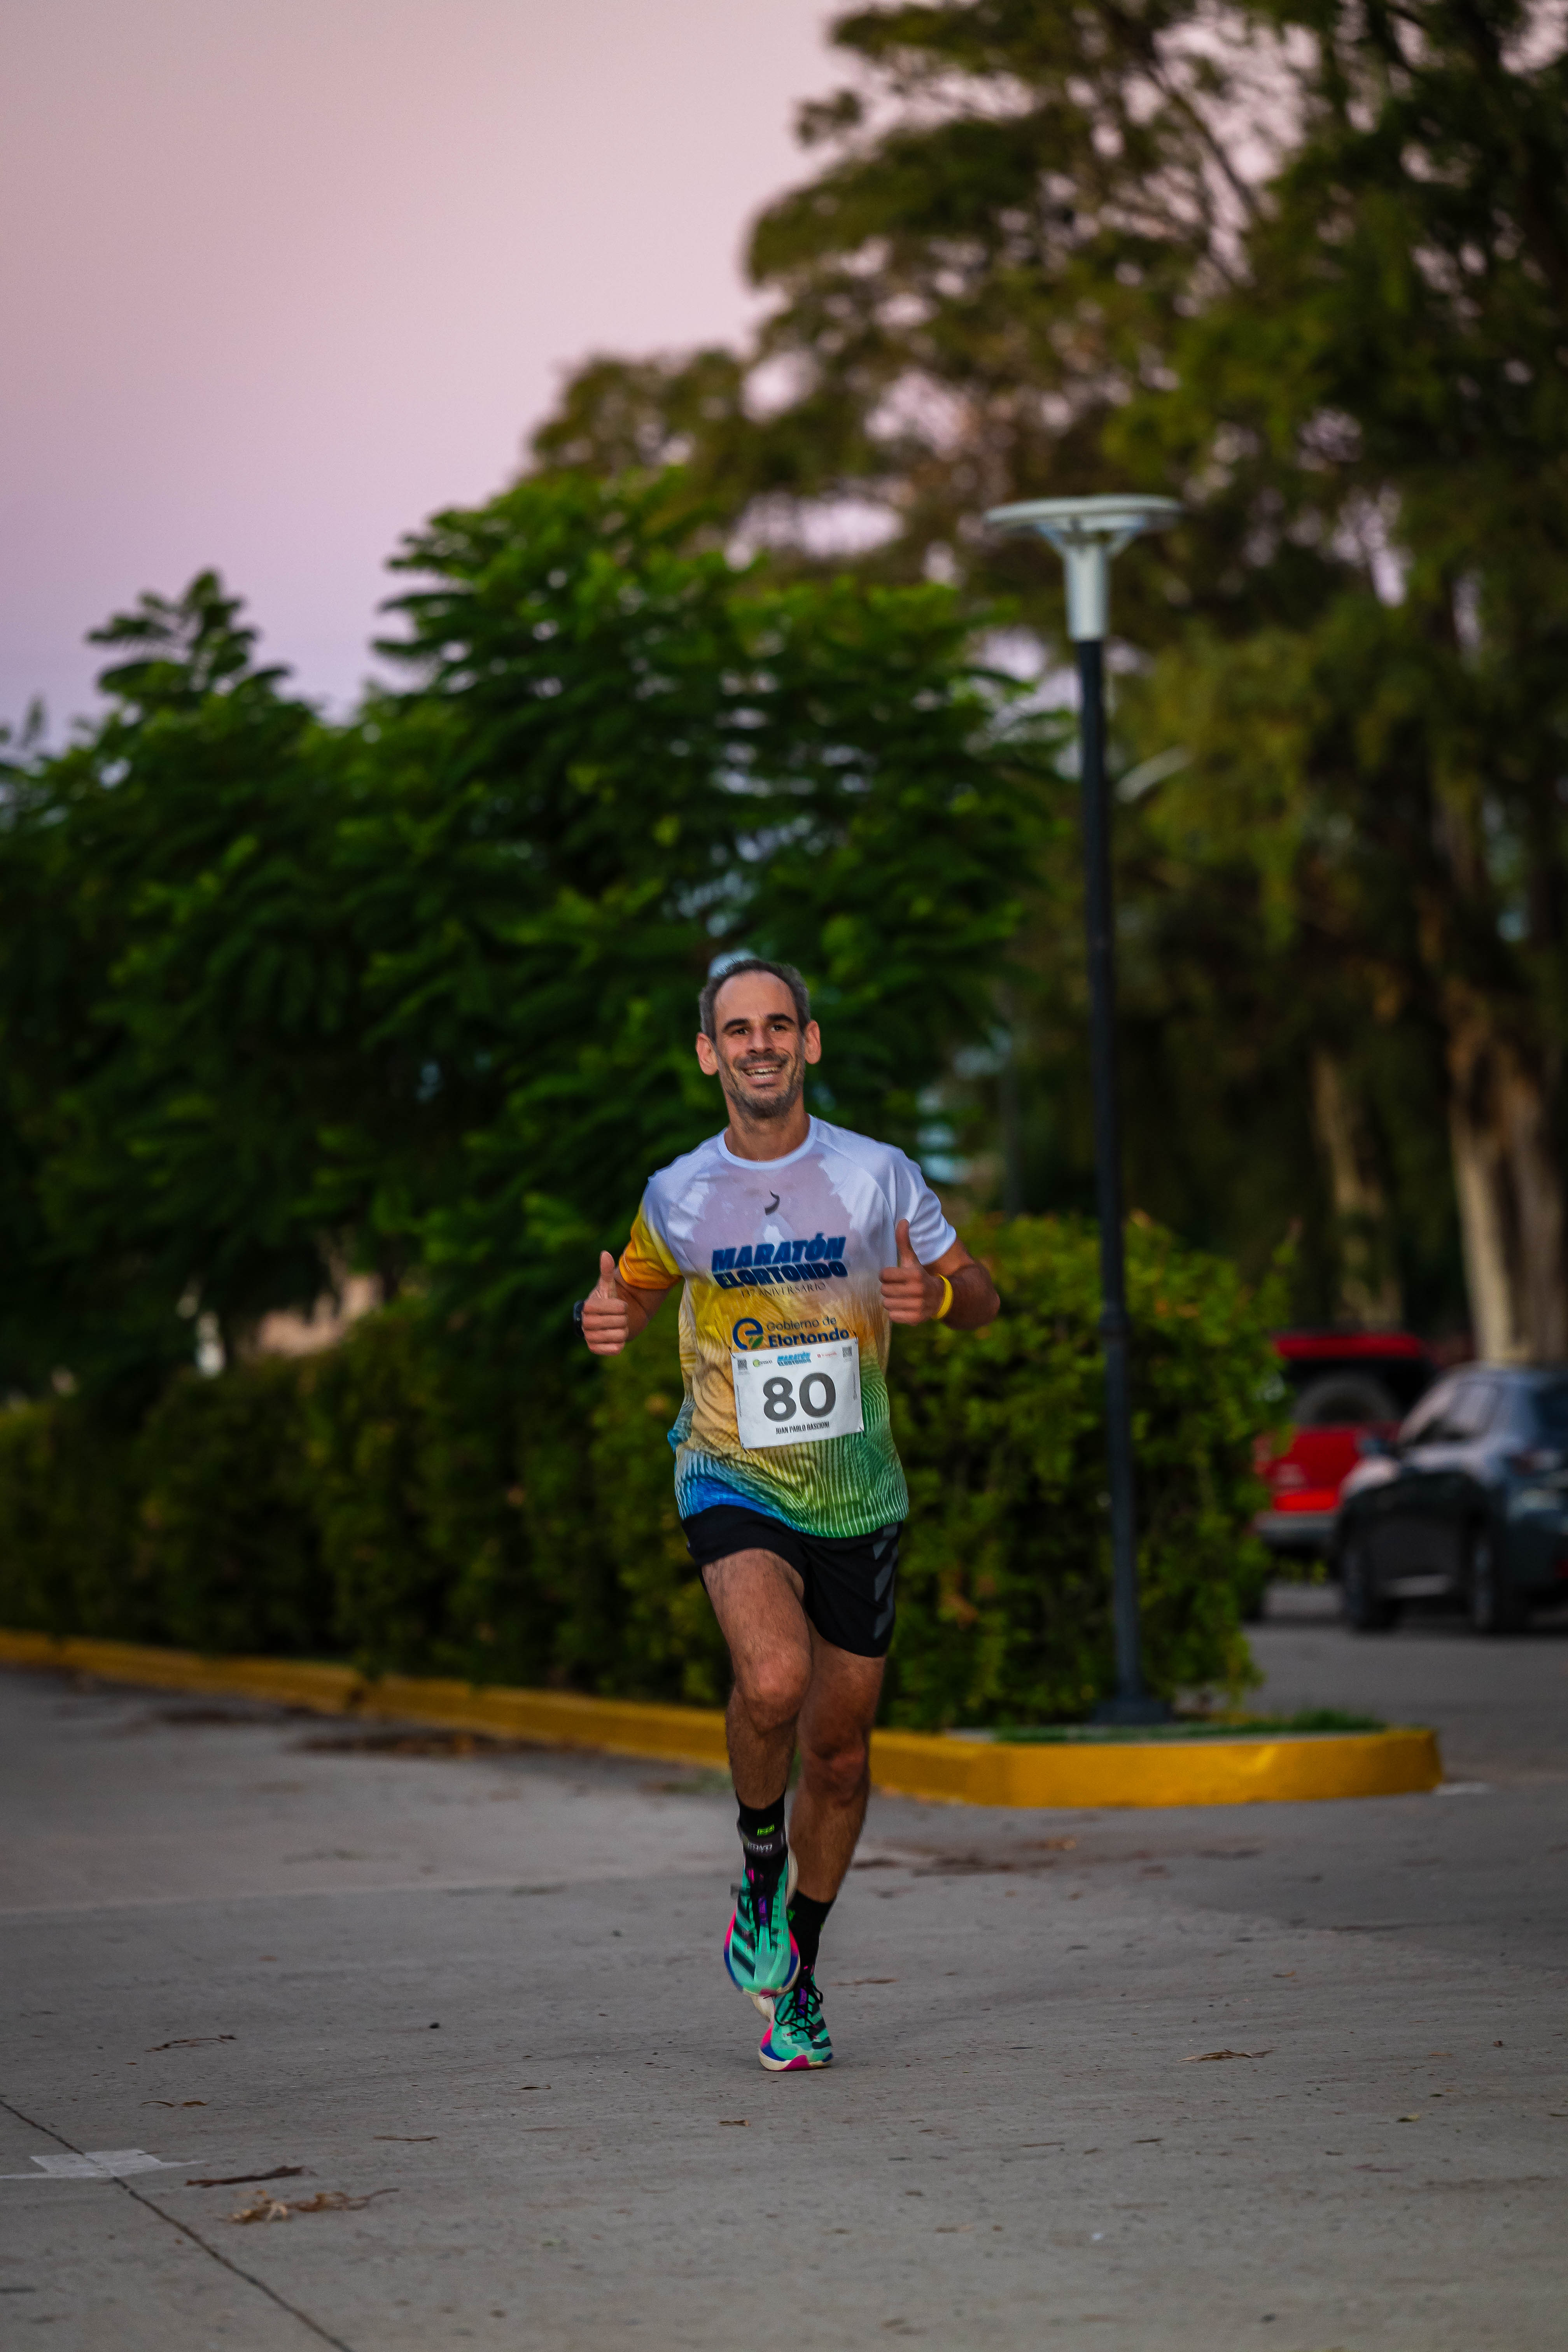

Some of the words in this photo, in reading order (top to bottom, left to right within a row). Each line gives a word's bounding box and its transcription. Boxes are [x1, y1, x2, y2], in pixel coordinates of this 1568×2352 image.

[711, 1232, 846, 1272] MARATÓN
[712, 1261, 848, 1290] ELORTONDO
[758, 1282, 826, 1297] ANIVERSARIO
[766, 1318, 819, 1331] Gobierno
[822, 1316, 837, 1326] de
[768, 1328, 849, 1348] Elortondo
[763, 1372, 836, 1422] 80
[775, 1426, 789, 1435] JUAN
[789, 1424, 806, 1433] PABLO
